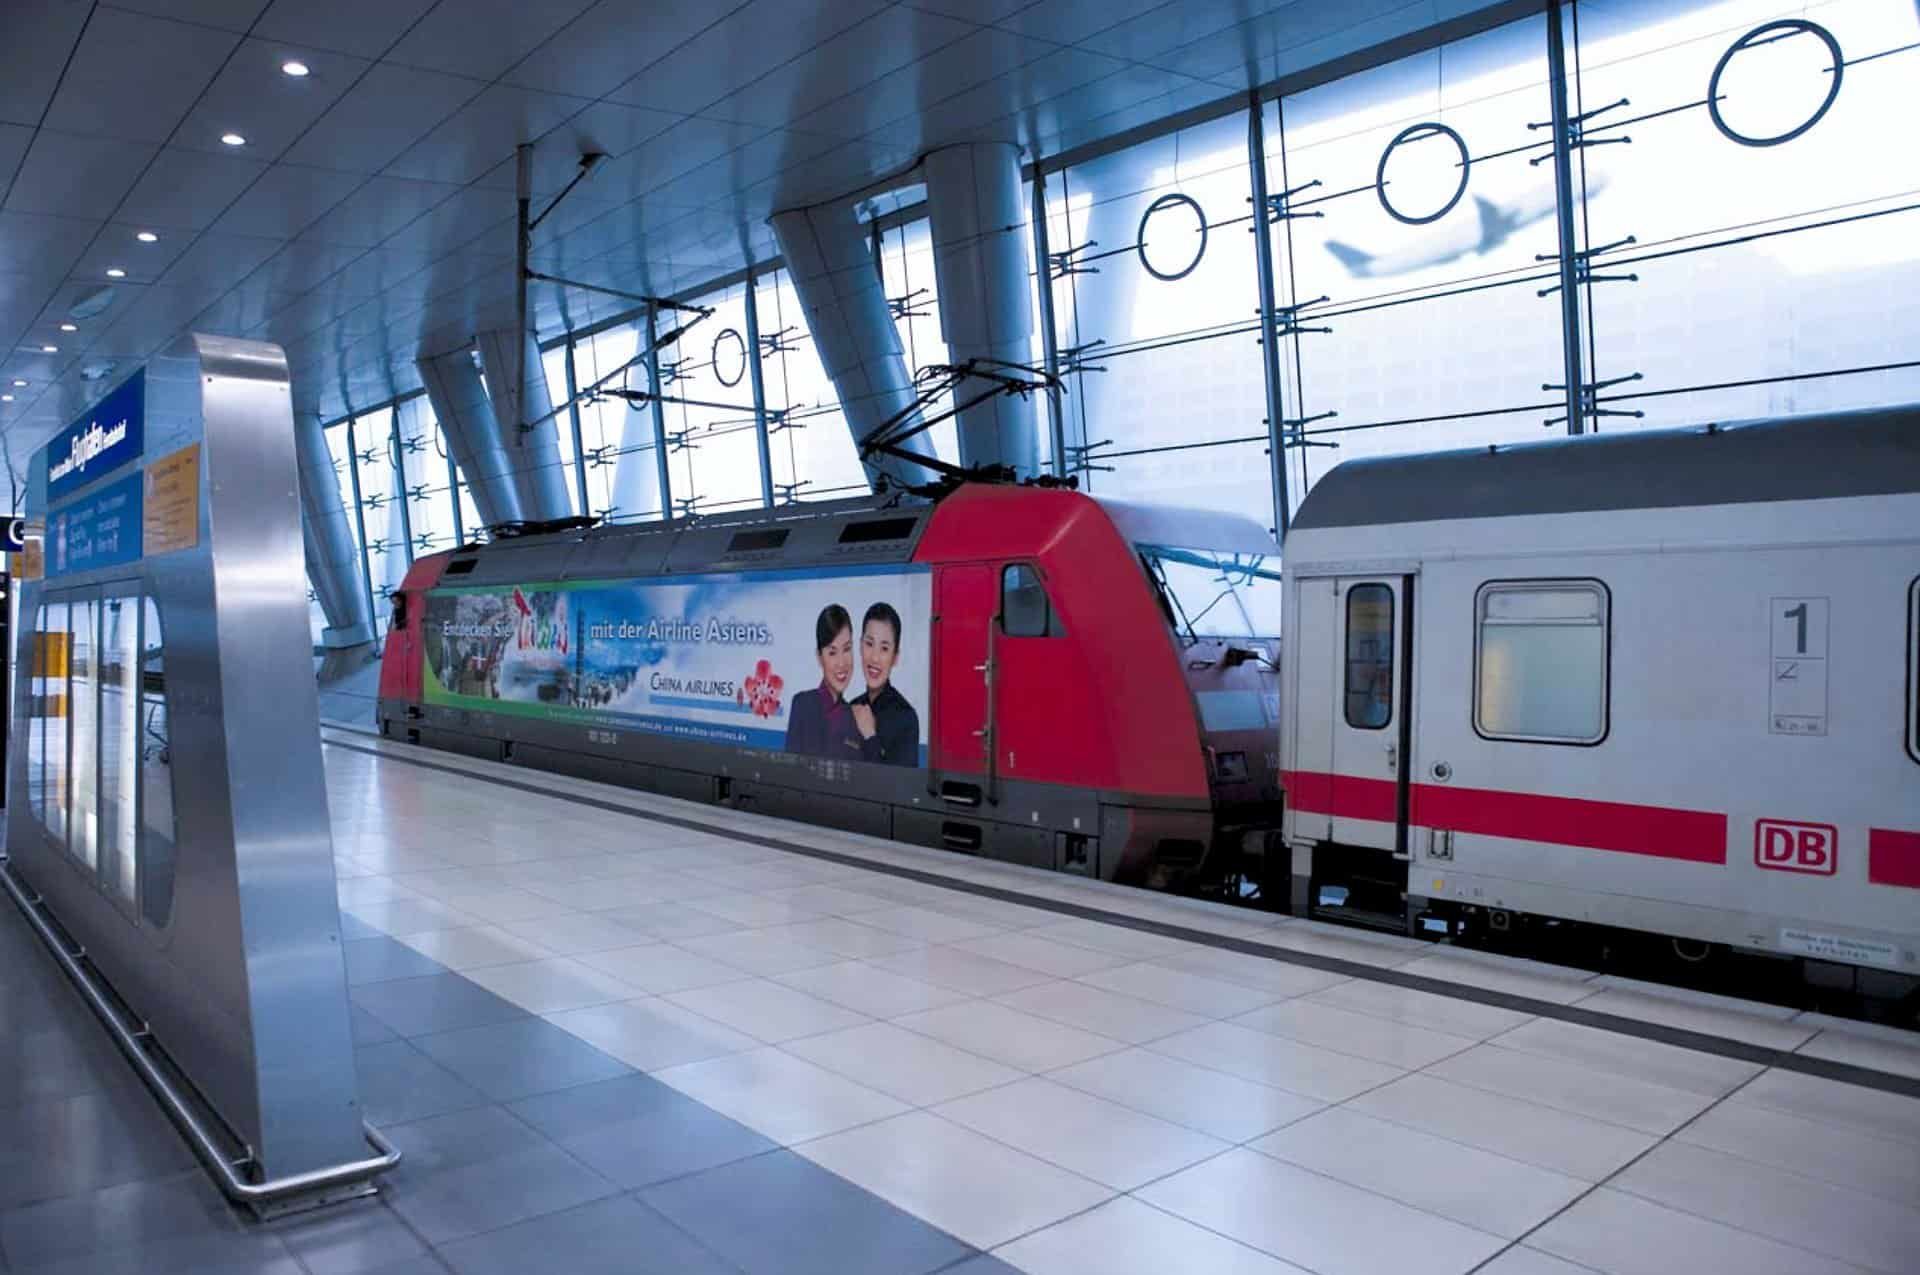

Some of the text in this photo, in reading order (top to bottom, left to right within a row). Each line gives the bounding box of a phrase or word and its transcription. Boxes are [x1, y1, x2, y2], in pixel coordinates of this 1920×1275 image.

[591, 619, 614, 639] mit
[618, 619, 643, 639] der
[647, 619, 702, 641] Airline
[706, 618, 774, 645] Asiens.
[1784, 602, 1808, 654] 1
[684, 679, 734, 697] AIRLINES
[1765, 826, 1827, 867] DB
